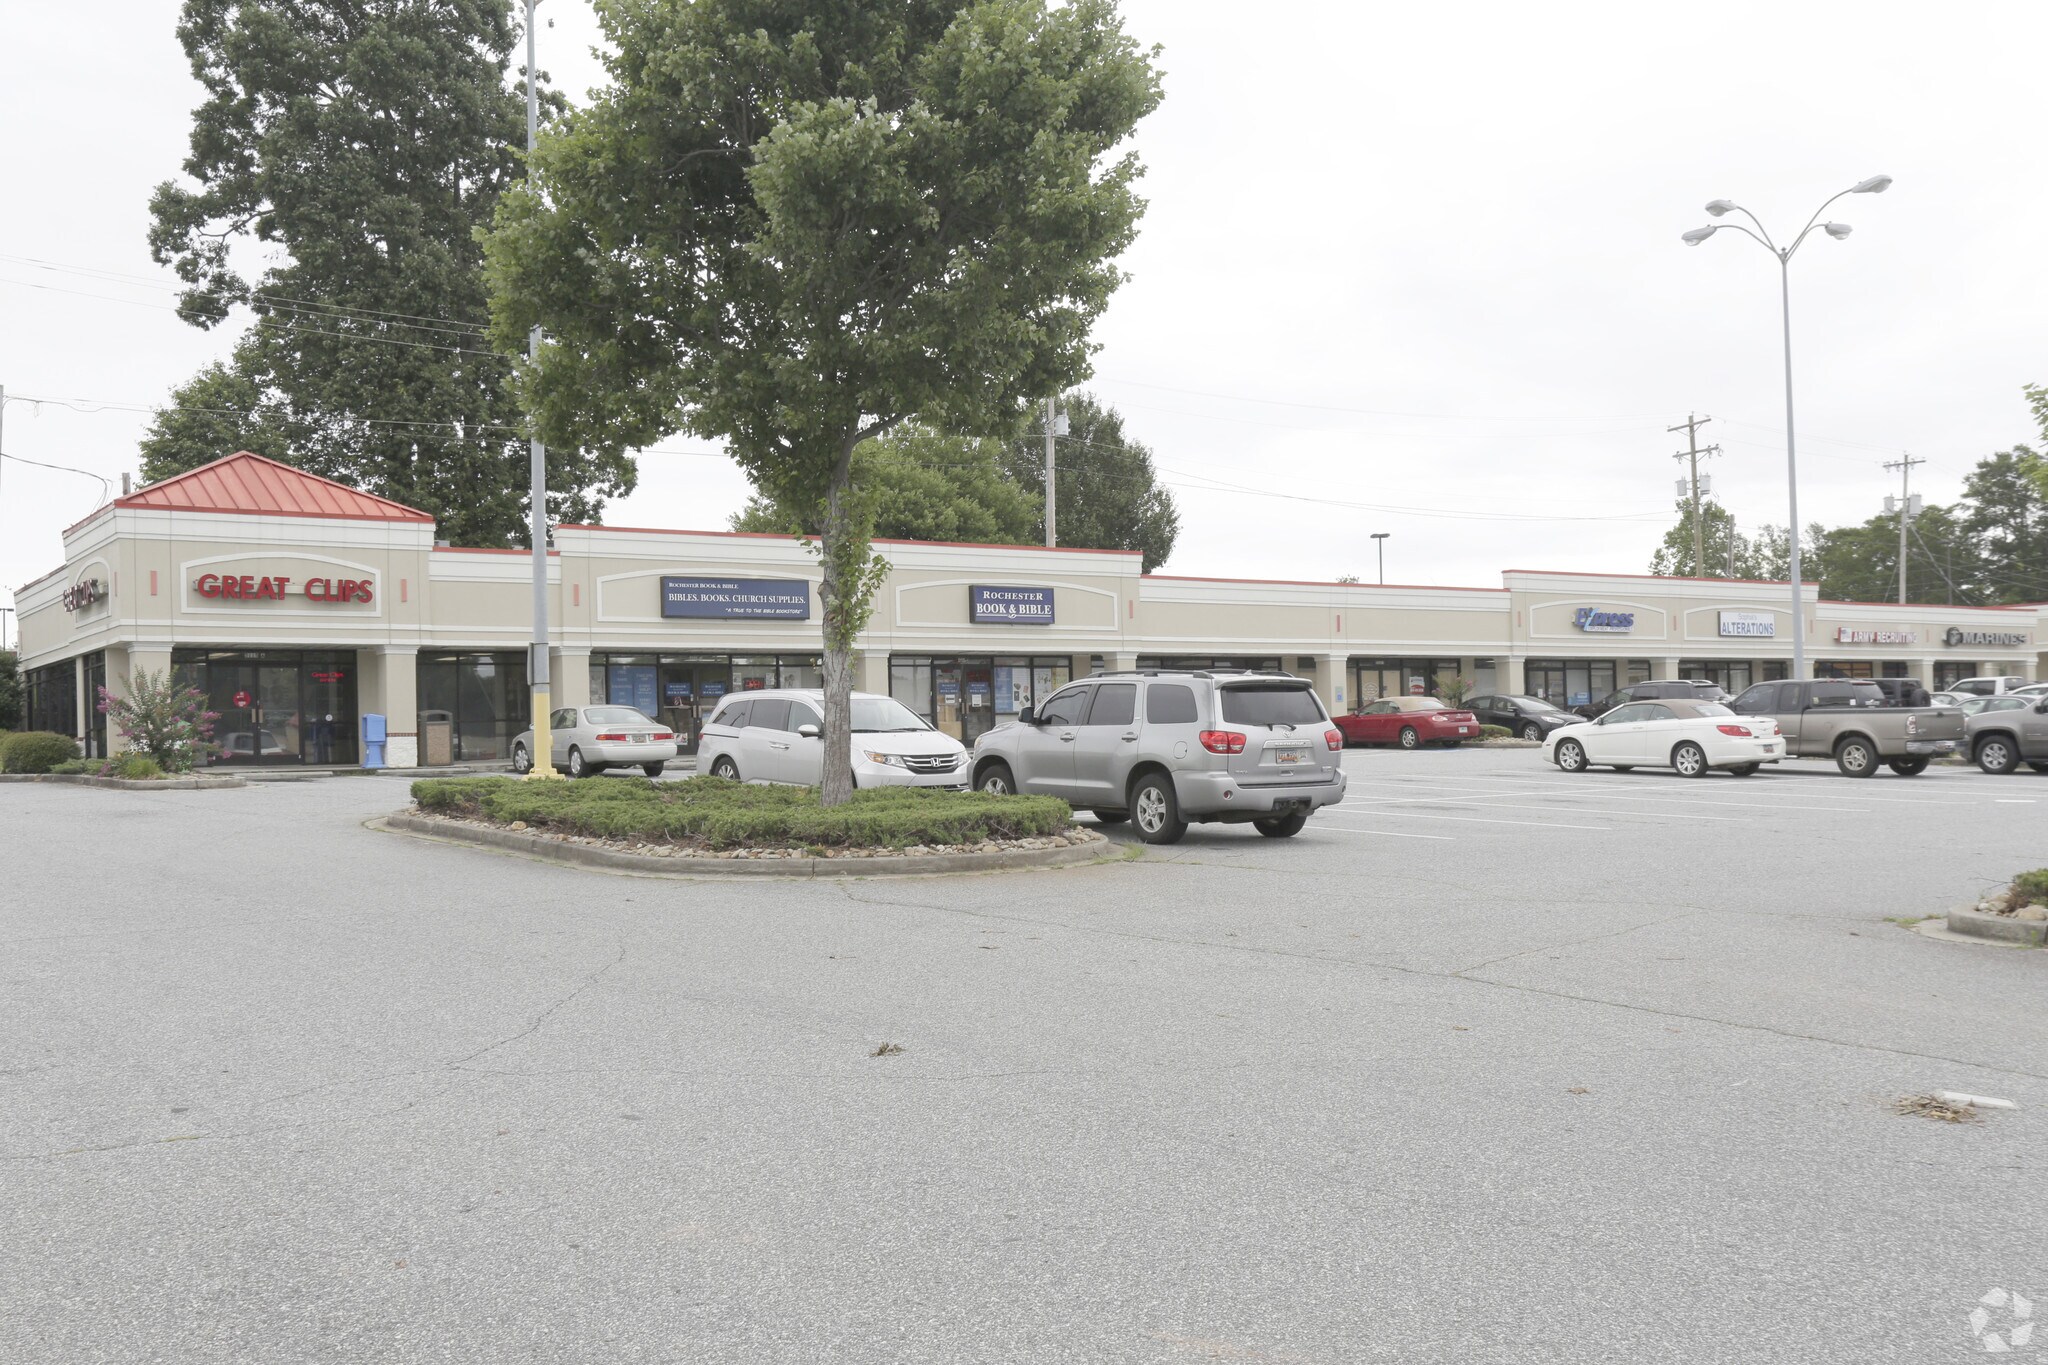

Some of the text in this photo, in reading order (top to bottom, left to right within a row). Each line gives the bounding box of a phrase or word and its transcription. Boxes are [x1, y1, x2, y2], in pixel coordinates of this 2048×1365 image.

[197, 573, 373, 604] GREAT CLIPS
[668, 593, 806, 604] BIBLES. BOOKS. CHURCH SUPPLIES.
[983, 590, 1043, 601] ROCHESTER
[976, 603, 1052, 615] BOOK & BIBLE
[1721, 622, 1774, 635] ALTERATIONS
[1852, 631, 1918, 643] ARMY RECRUITING
[1962, 632, 2027, 645] MARINES
